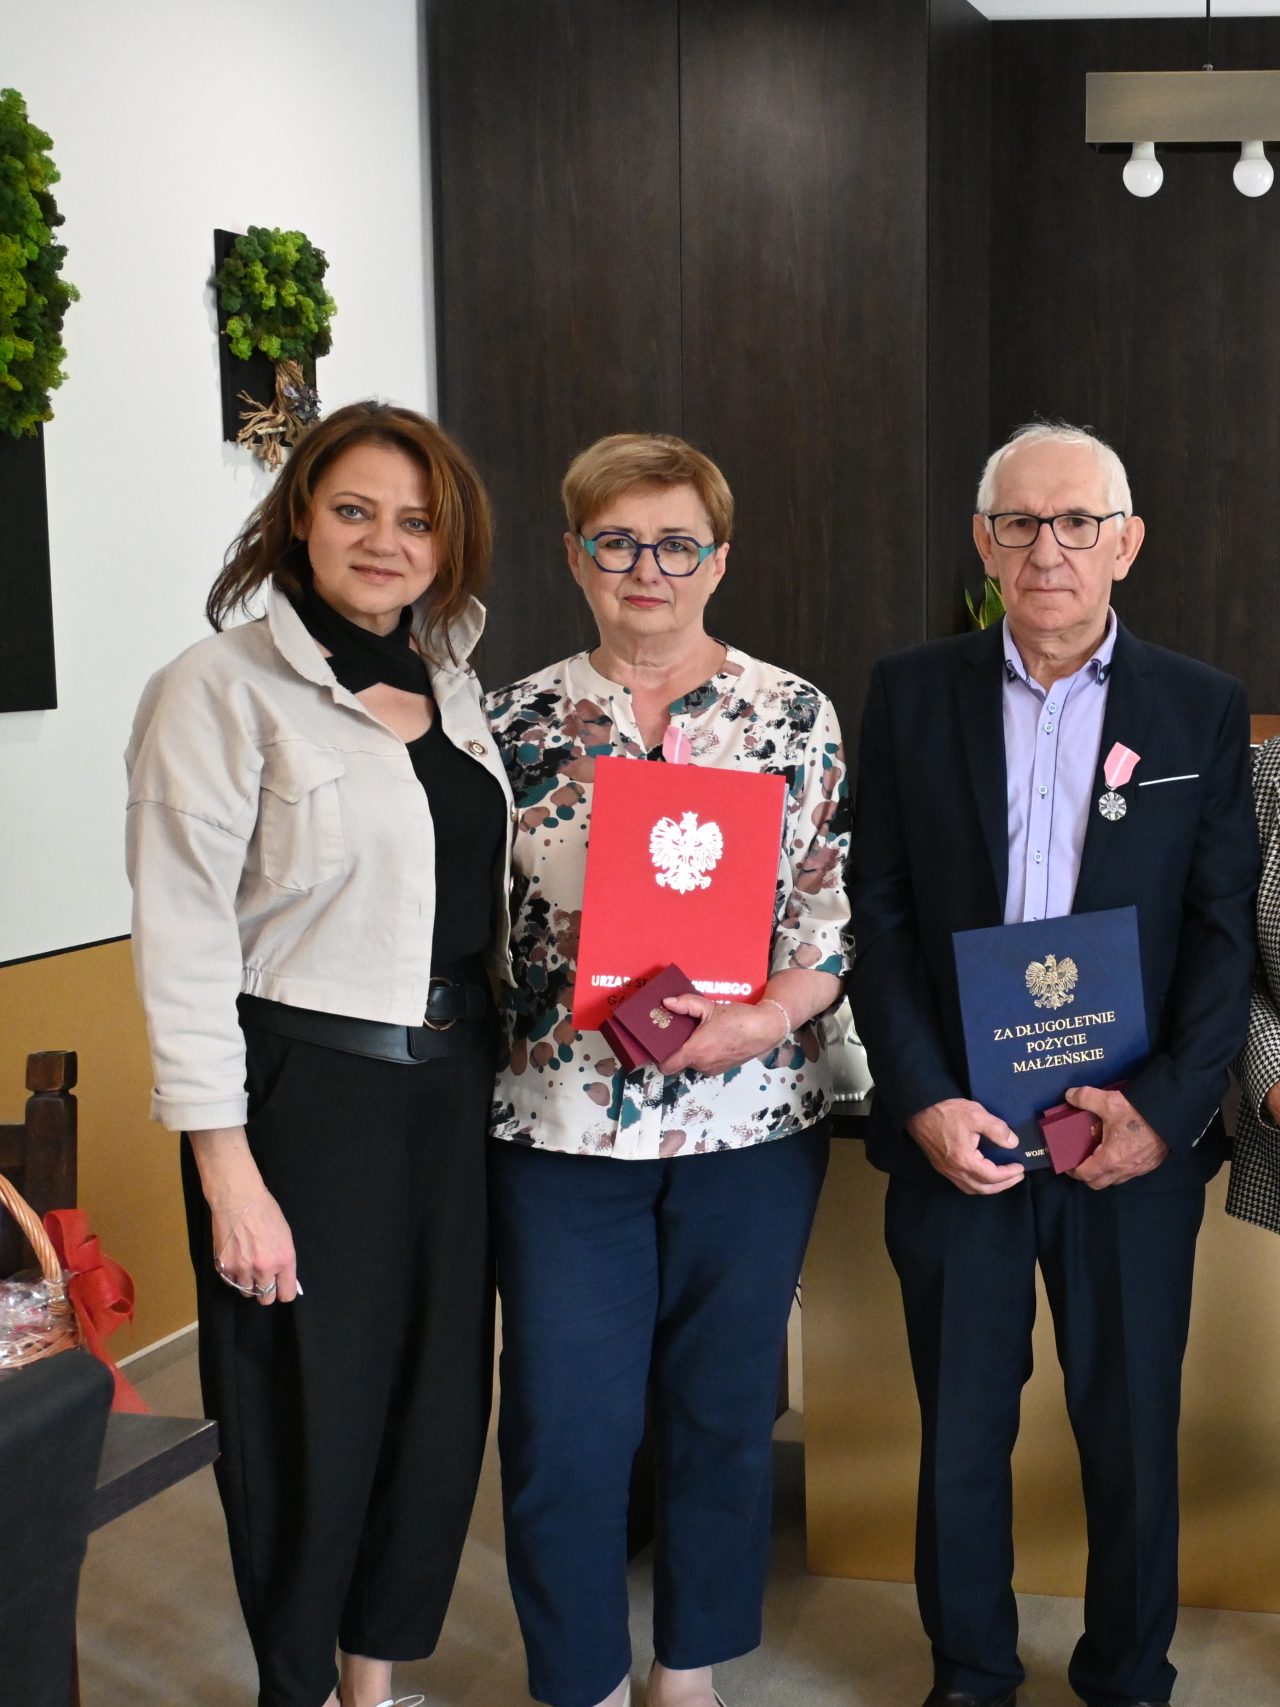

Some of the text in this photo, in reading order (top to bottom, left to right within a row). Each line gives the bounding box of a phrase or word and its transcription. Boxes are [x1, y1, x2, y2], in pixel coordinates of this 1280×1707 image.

[993, 1011, 1116, 1041] ZA DŁUGOLETNIE
[1026, 1033, 1088, 1053] POŻYCIE
[1012, 1048, 1105, 1073] MAŁŻEŃSKIE
